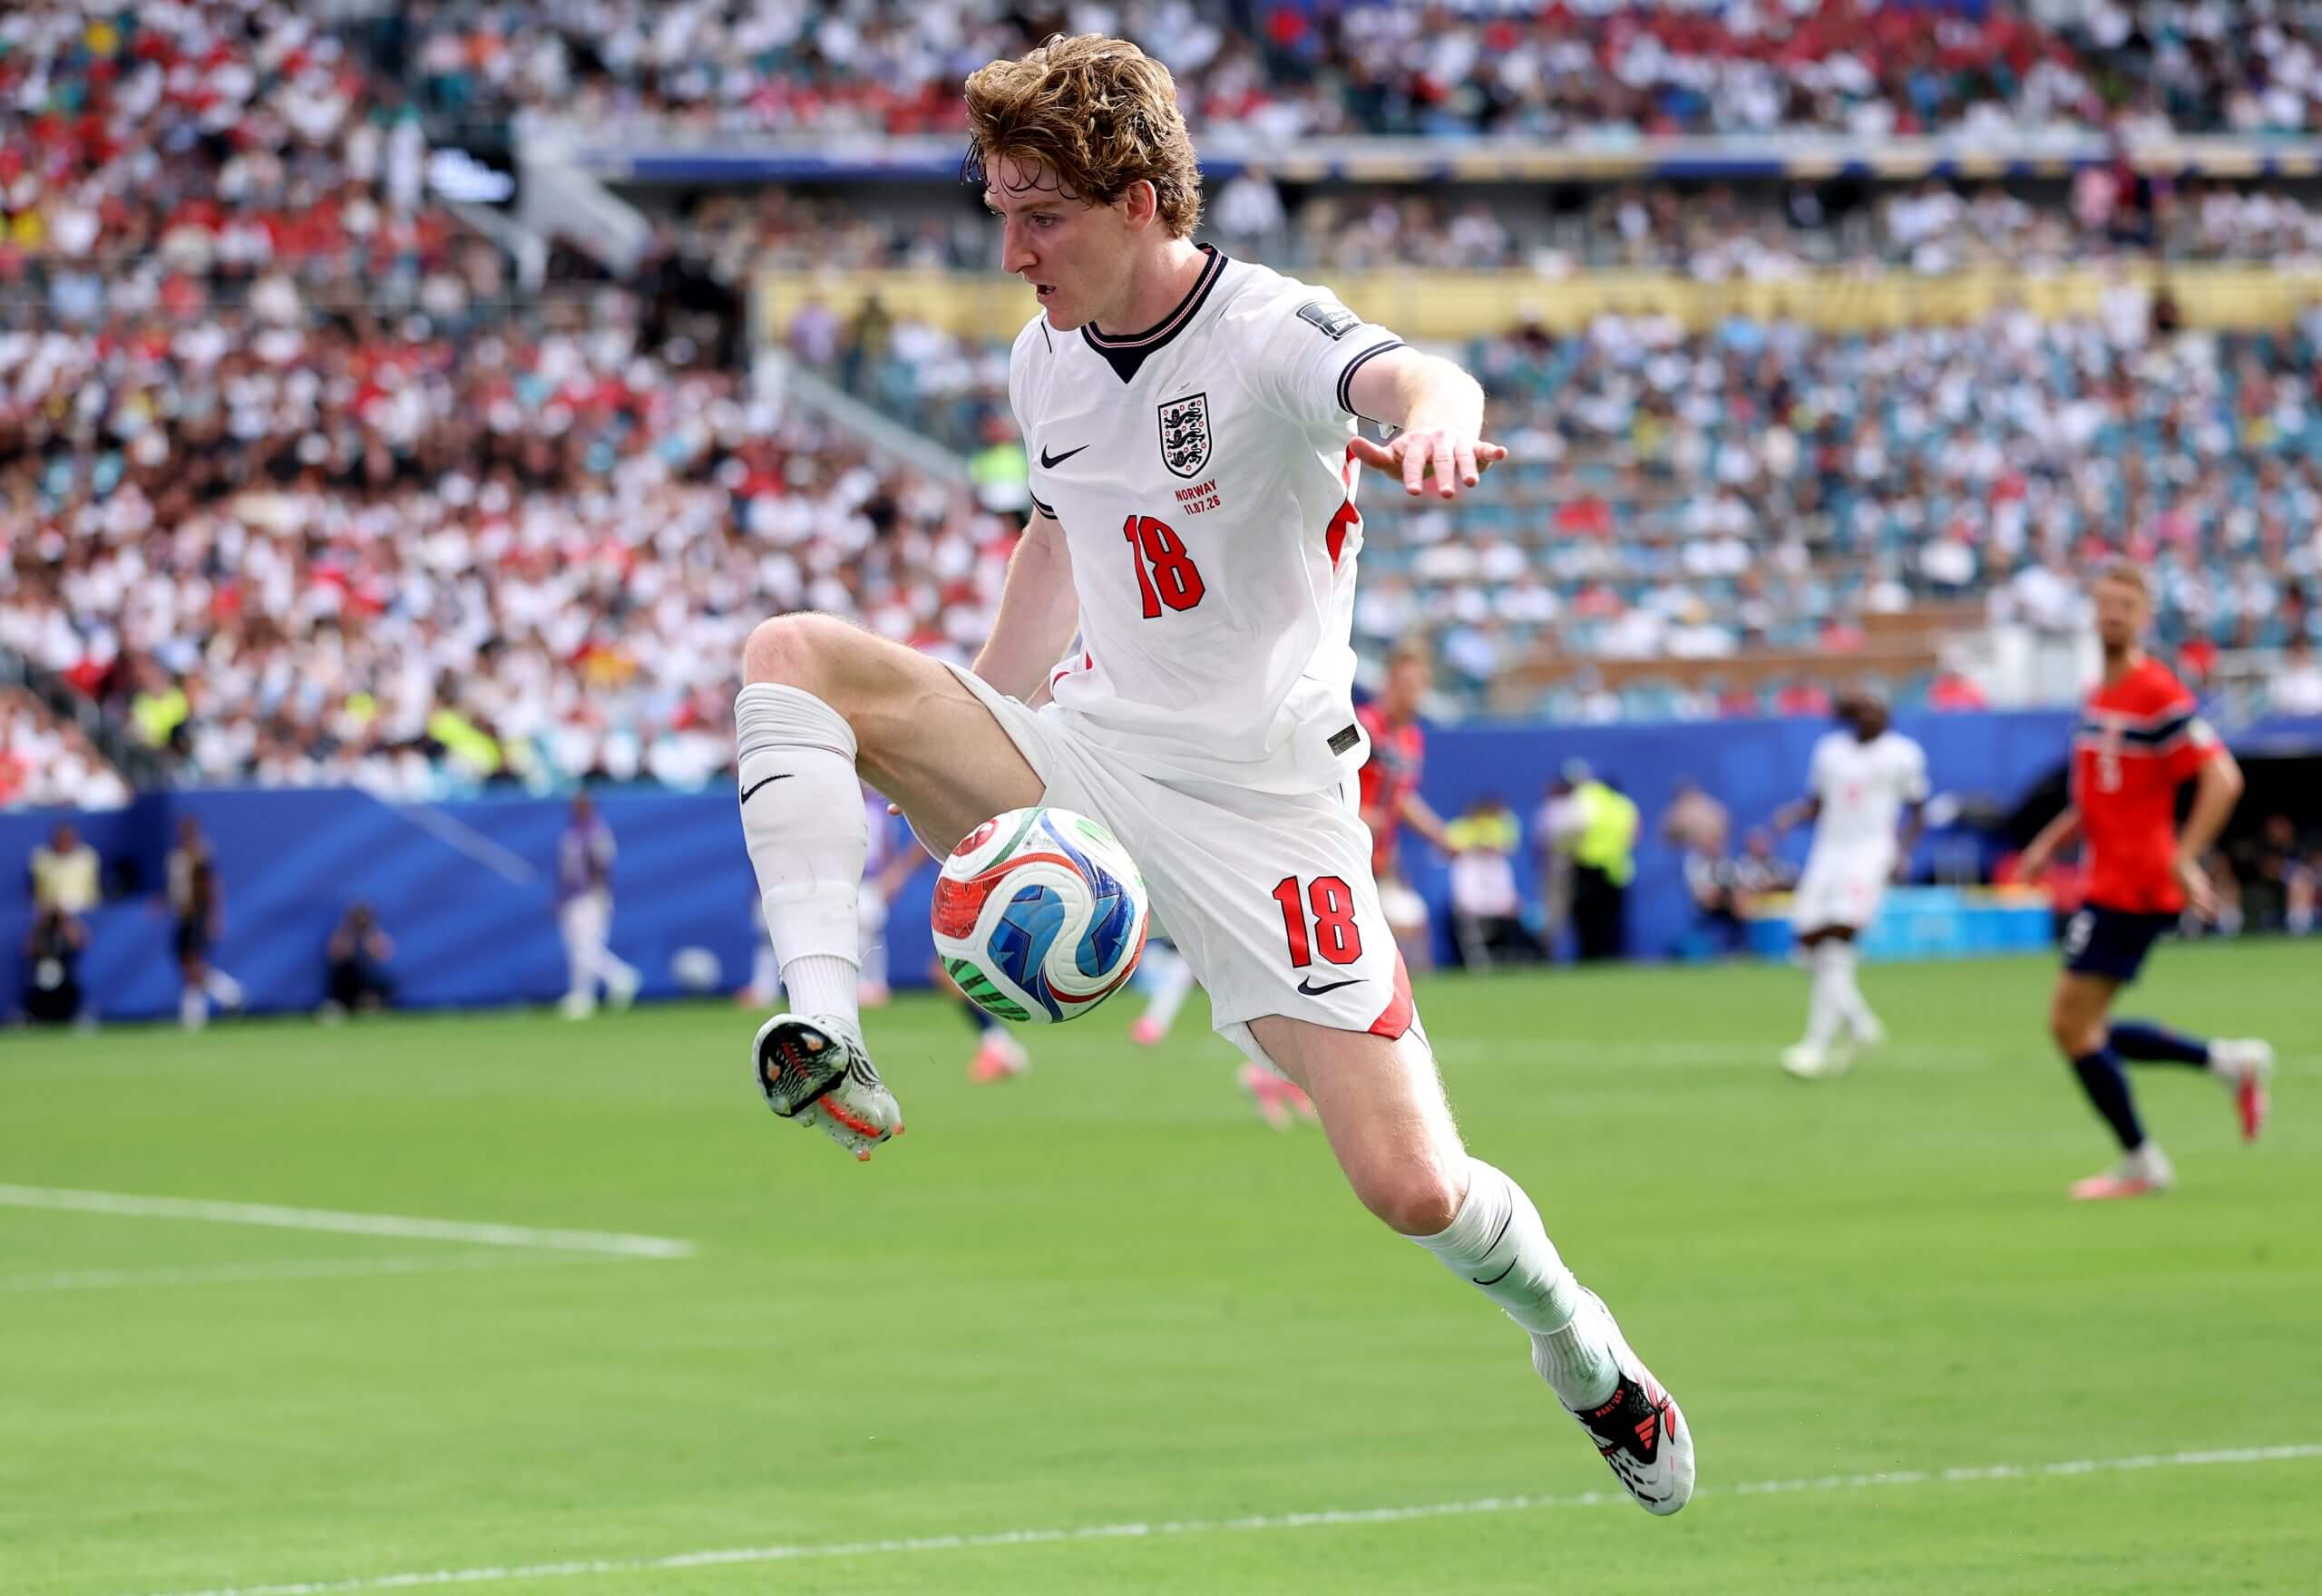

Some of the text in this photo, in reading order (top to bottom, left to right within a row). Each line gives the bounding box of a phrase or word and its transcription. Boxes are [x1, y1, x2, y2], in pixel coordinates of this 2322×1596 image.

[1175, 479, 1217, 501] NORWAY
[1184, 495, 1221, 515] 11.07.26
[1123, 514, 1205, 619] 18
[1272, 875, 1362, 968] 18
